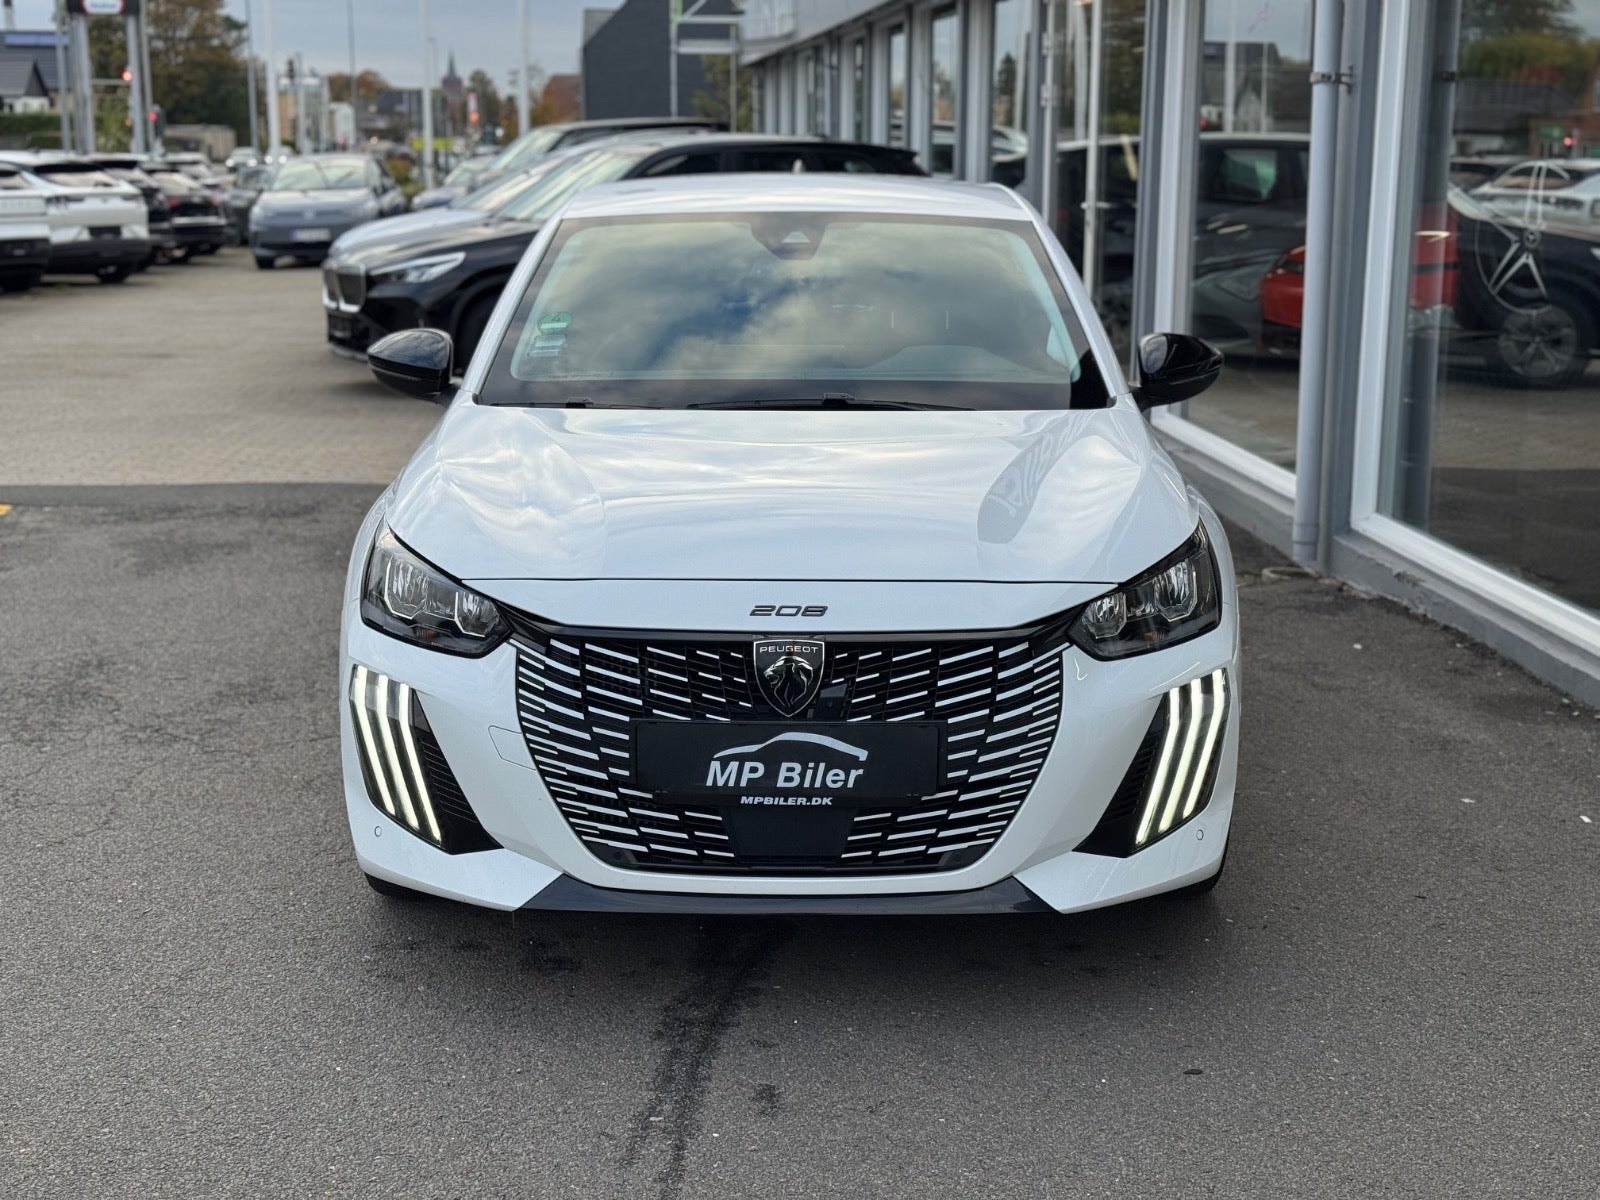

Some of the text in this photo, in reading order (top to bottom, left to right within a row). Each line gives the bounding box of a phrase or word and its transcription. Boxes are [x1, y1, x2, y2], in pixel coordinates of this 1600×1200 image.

[749, 605, 828, 617] 208
[759, 645, 819, 653] PEUGEOT
[705, 760, 864, 789] MP Biler
[740, 795, 833, 806] MPBILER.DK
